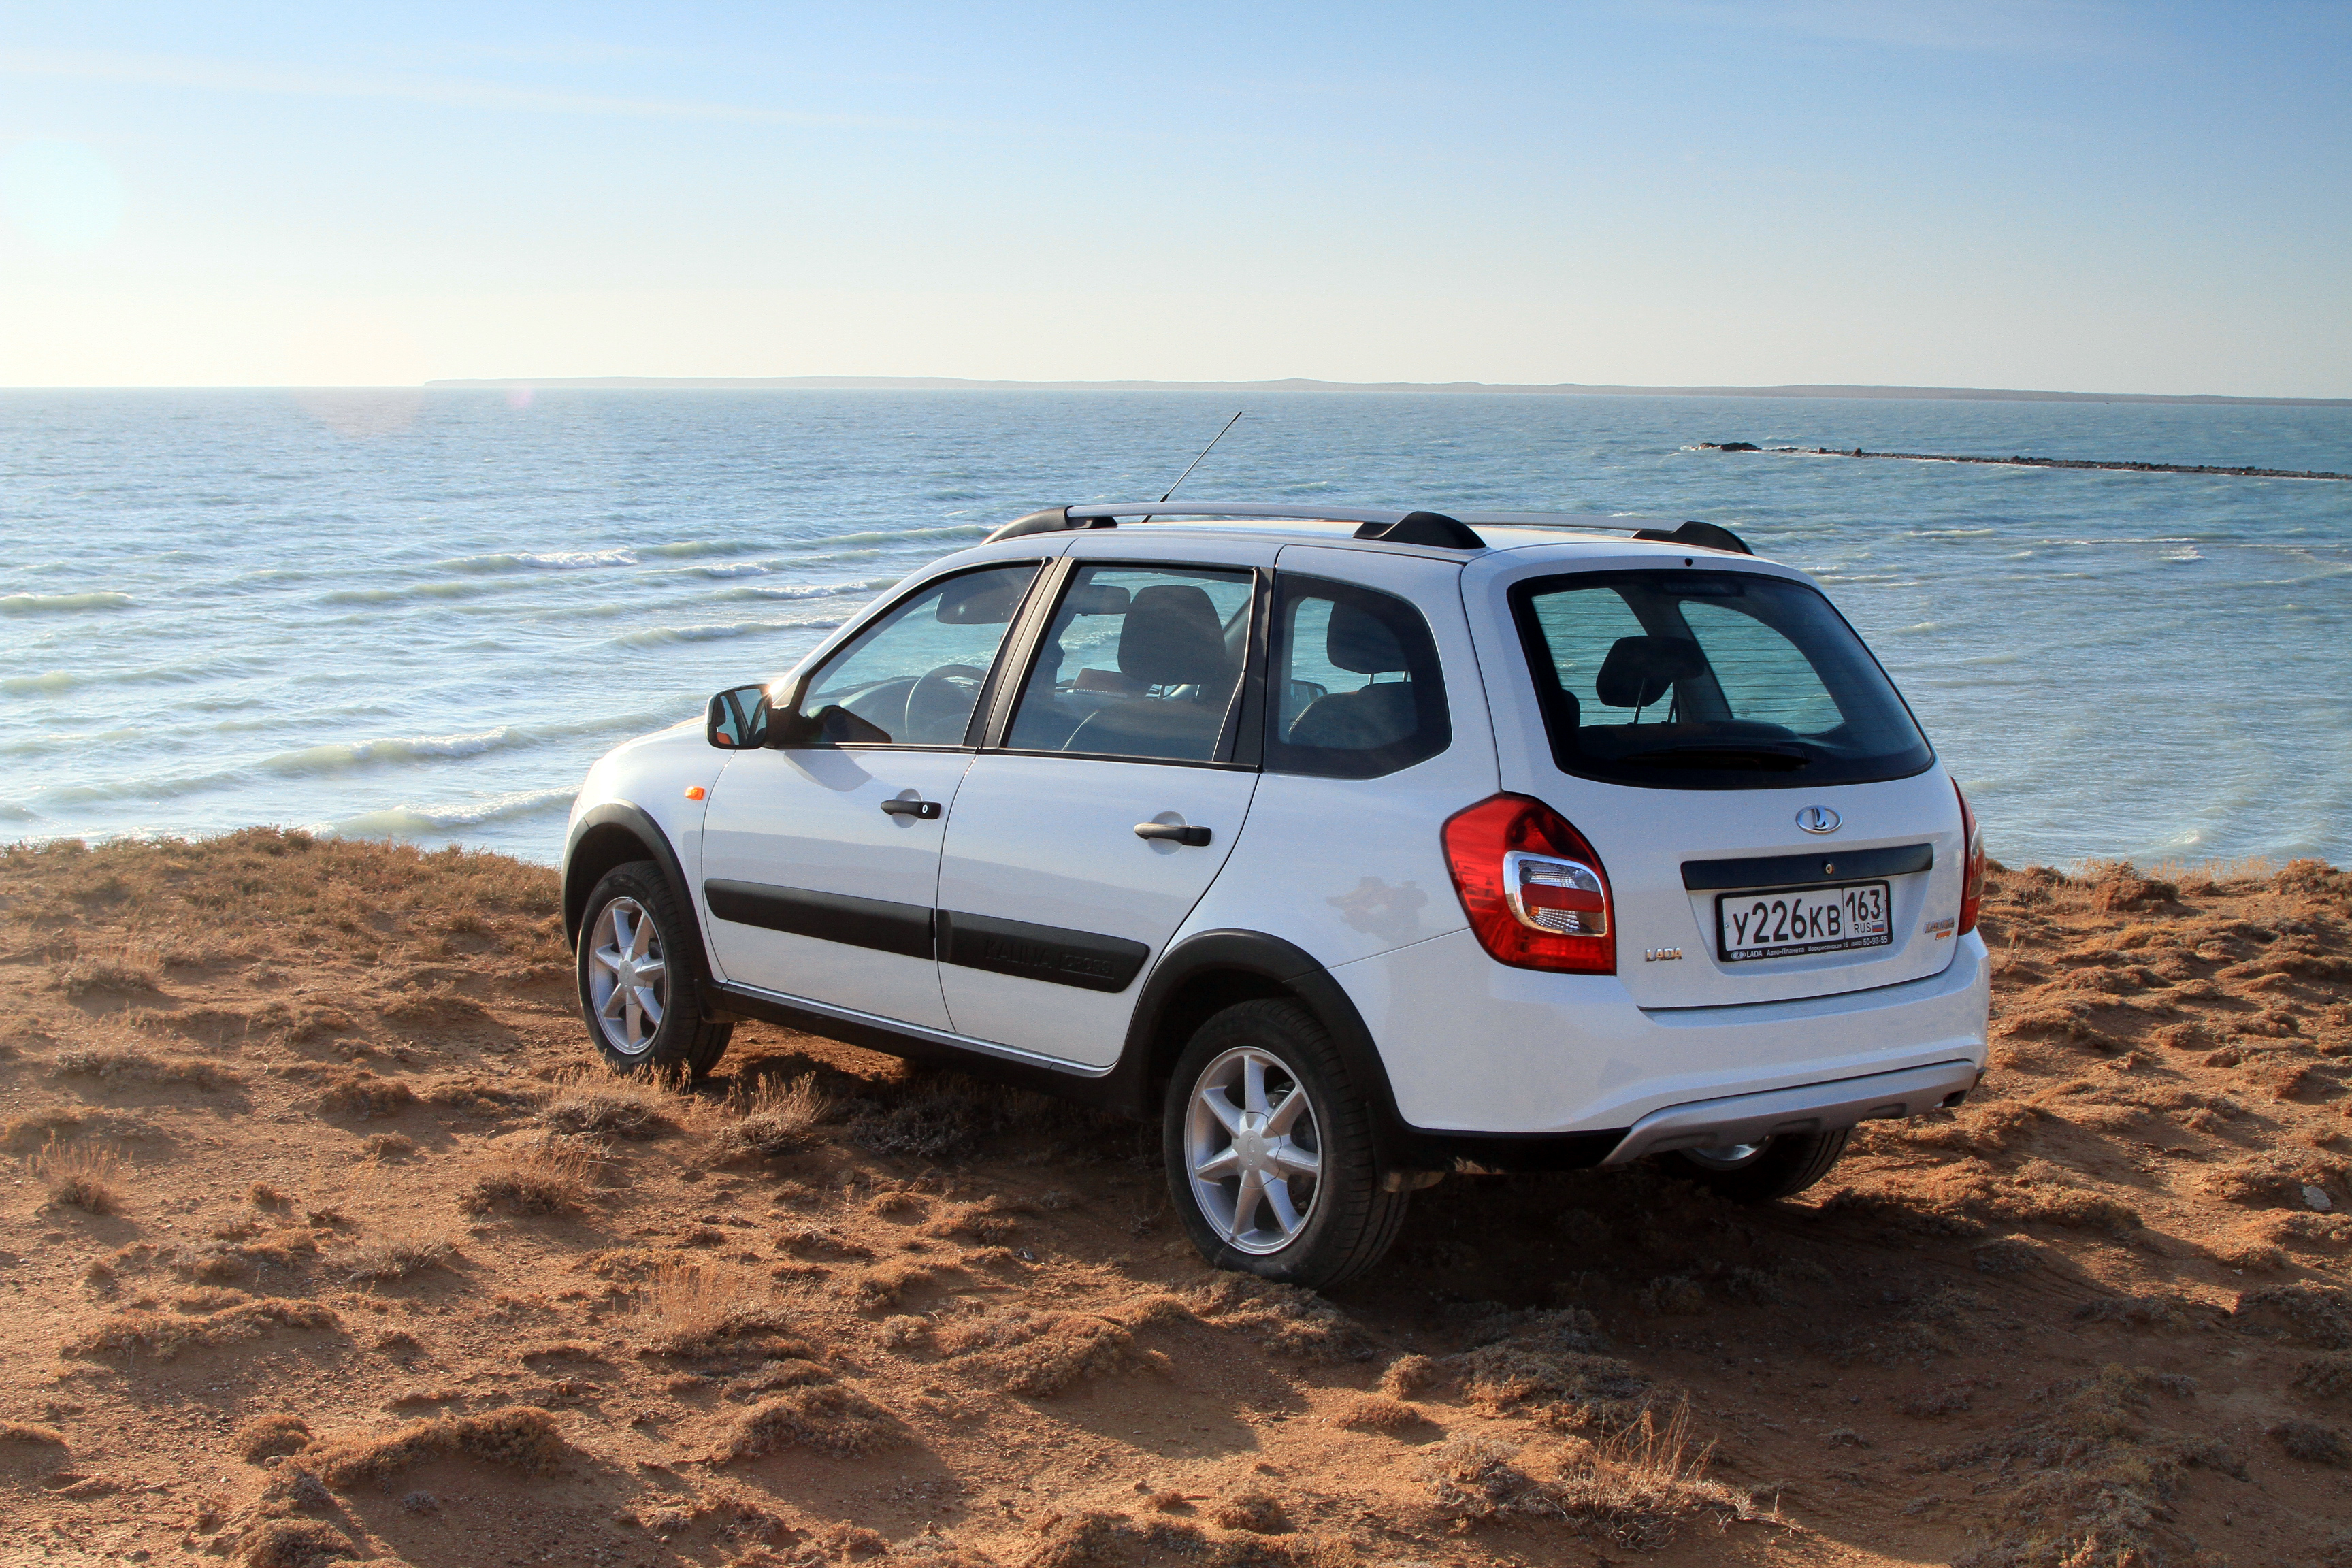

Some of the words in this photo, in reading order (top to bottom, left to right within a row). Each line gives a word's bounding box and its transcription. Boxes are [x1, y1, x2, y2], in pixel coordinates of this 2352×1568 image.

[1845, 889, 1880, 923] 163
[1854, 921, 1872, 934] RUS
[1646, 947, 1682, 962] LADA
[1767, 947, 1805, 956] Авто-Планета
[1863, 936, 1888, 946] 50-93-55
